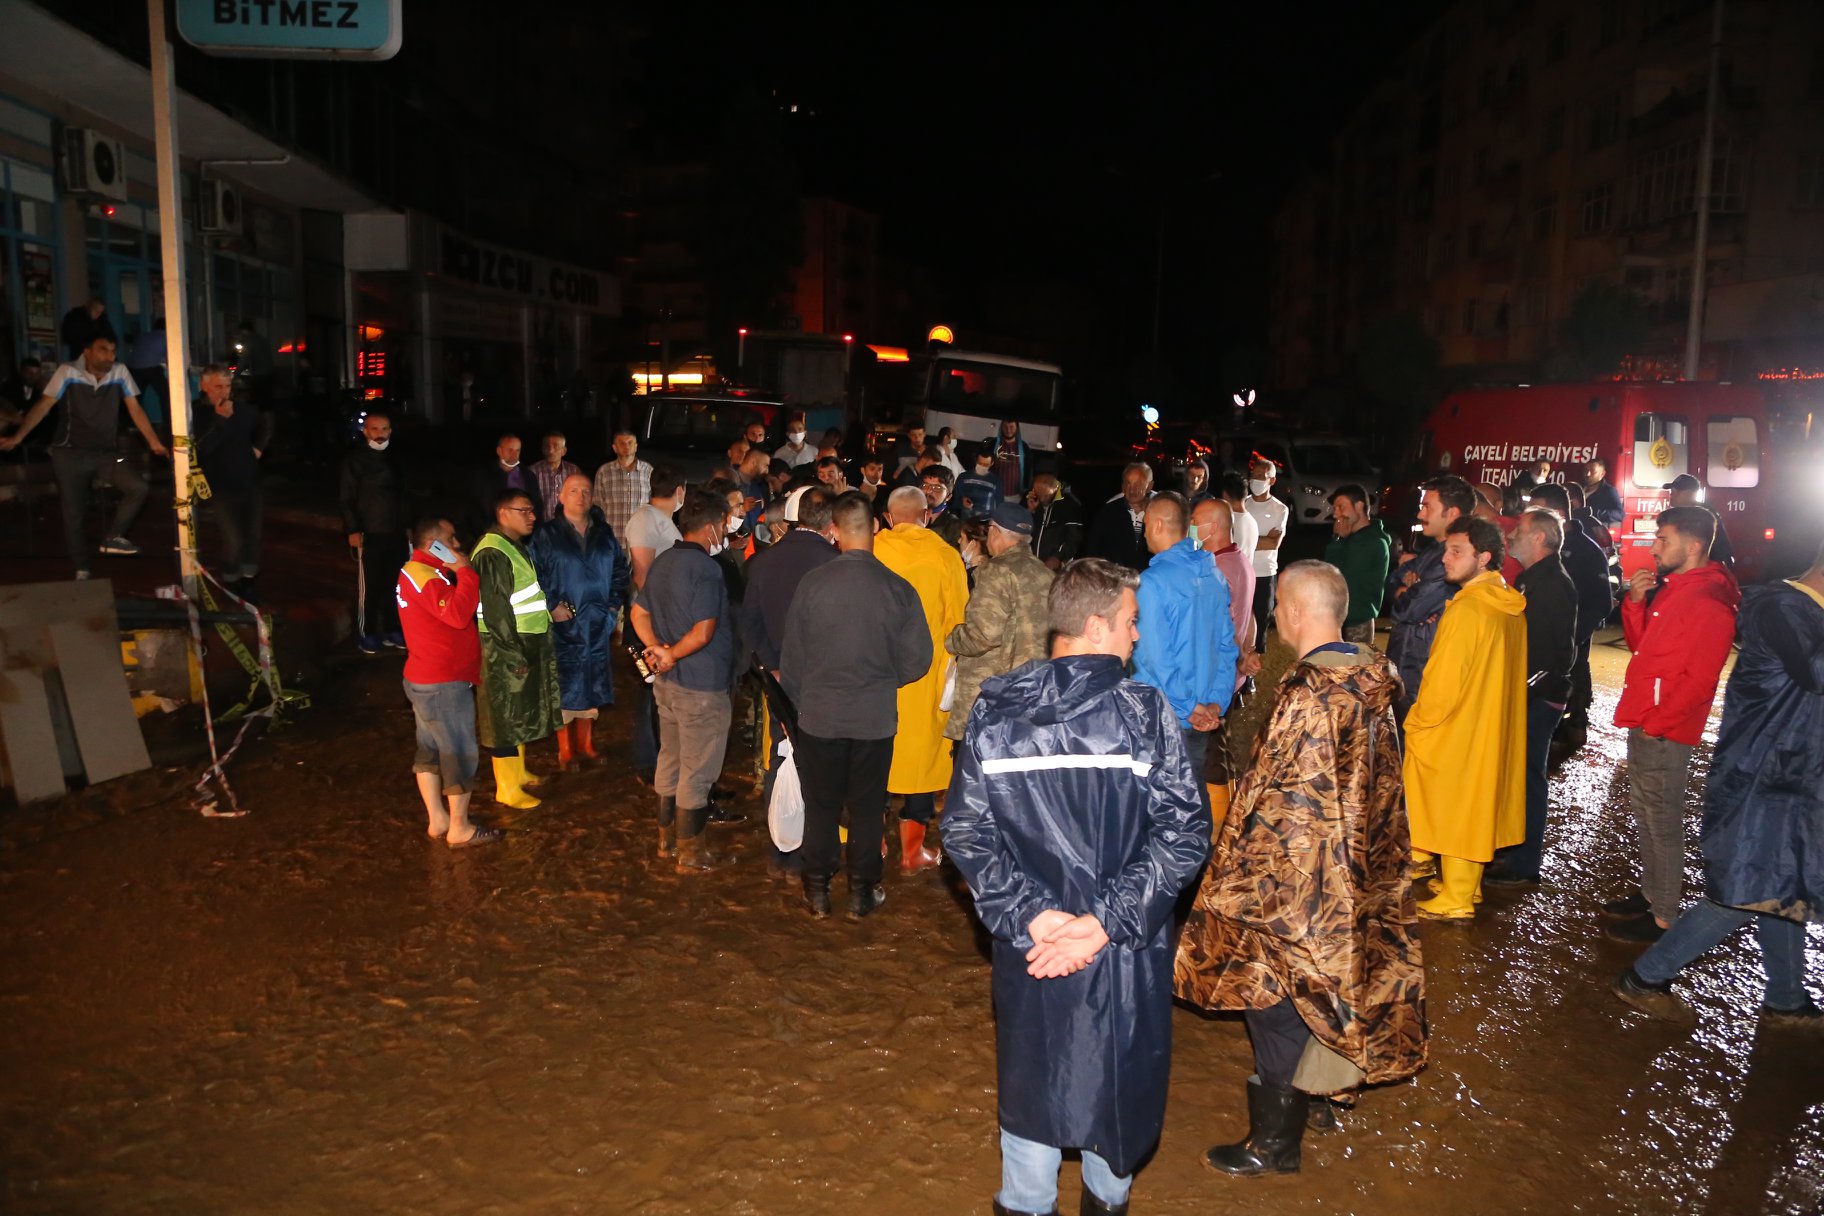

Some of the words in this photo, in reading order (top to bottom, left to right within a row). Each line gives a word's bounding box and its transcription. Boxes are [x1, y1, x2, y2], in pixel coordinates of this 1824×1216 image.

[1464, 441, 1509, 464] ÇAYELİ
[1510, 442, 1599, 464] BELEDİYESİ
[1480, 463, 1529, 487] İTFAİY
[1726, 500, 1746, 512] 110
